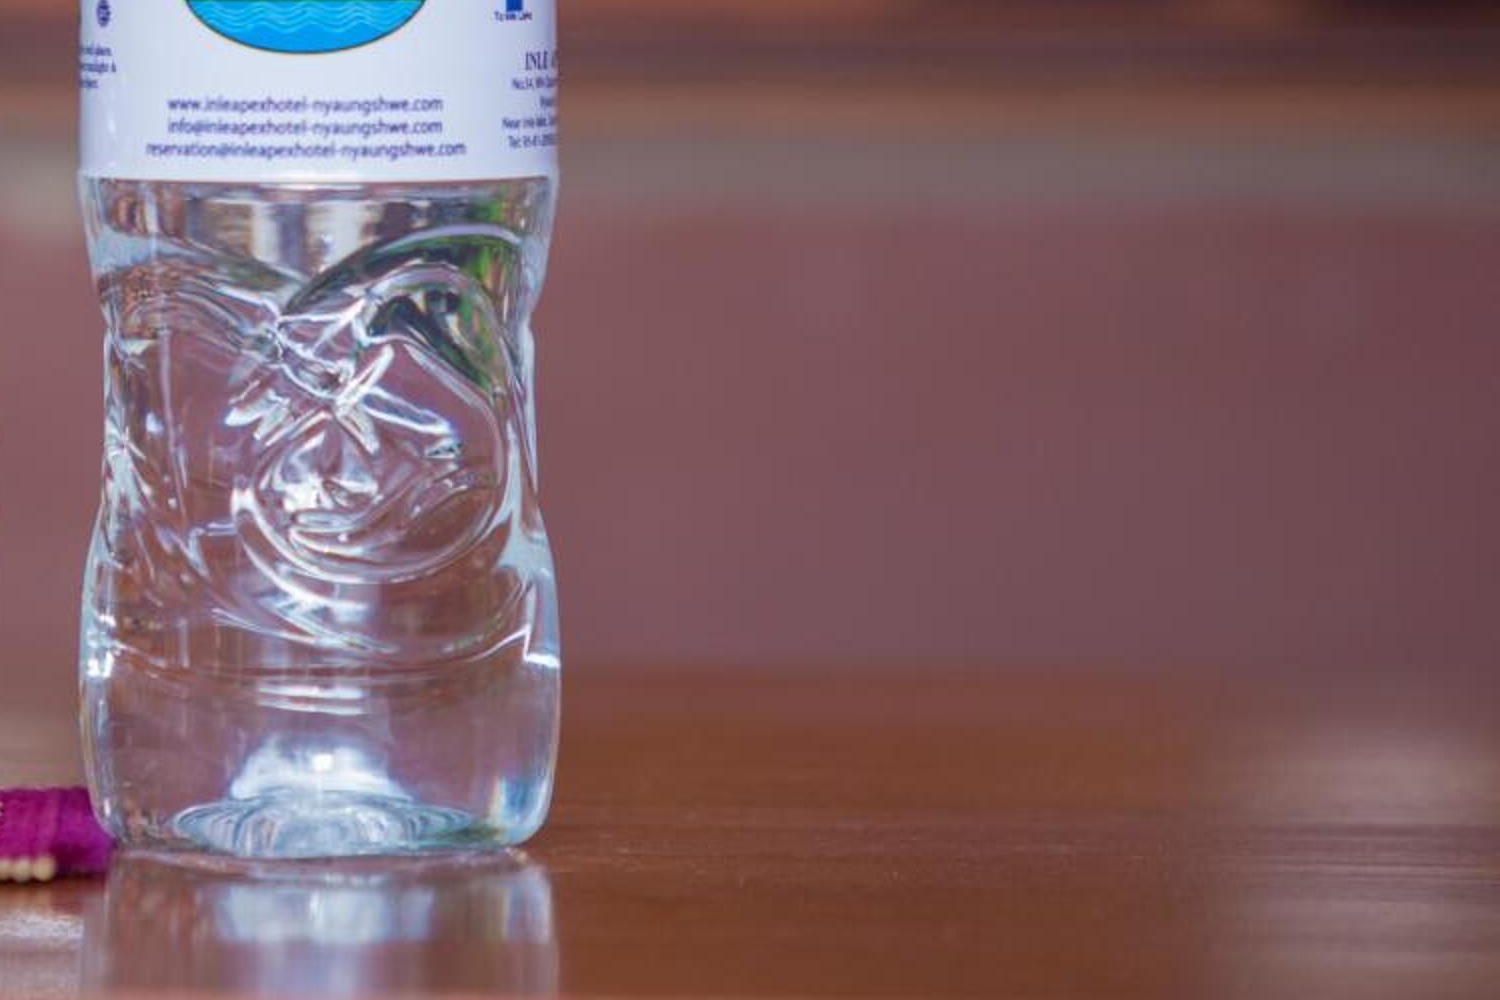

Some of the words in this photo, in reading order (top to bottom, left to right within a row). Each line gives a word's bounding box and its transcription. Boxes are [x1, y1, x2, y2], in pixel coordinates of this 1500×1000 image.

[168, 95, 444, 116] www.inleapexhotel-nyaungshwe.com
[168, 117, 443, 138] info@inleapexhotel-nyaungshwe.com
[146, 140, 467, 161] reservation@inleapexhotel-nyaungshwe.com
